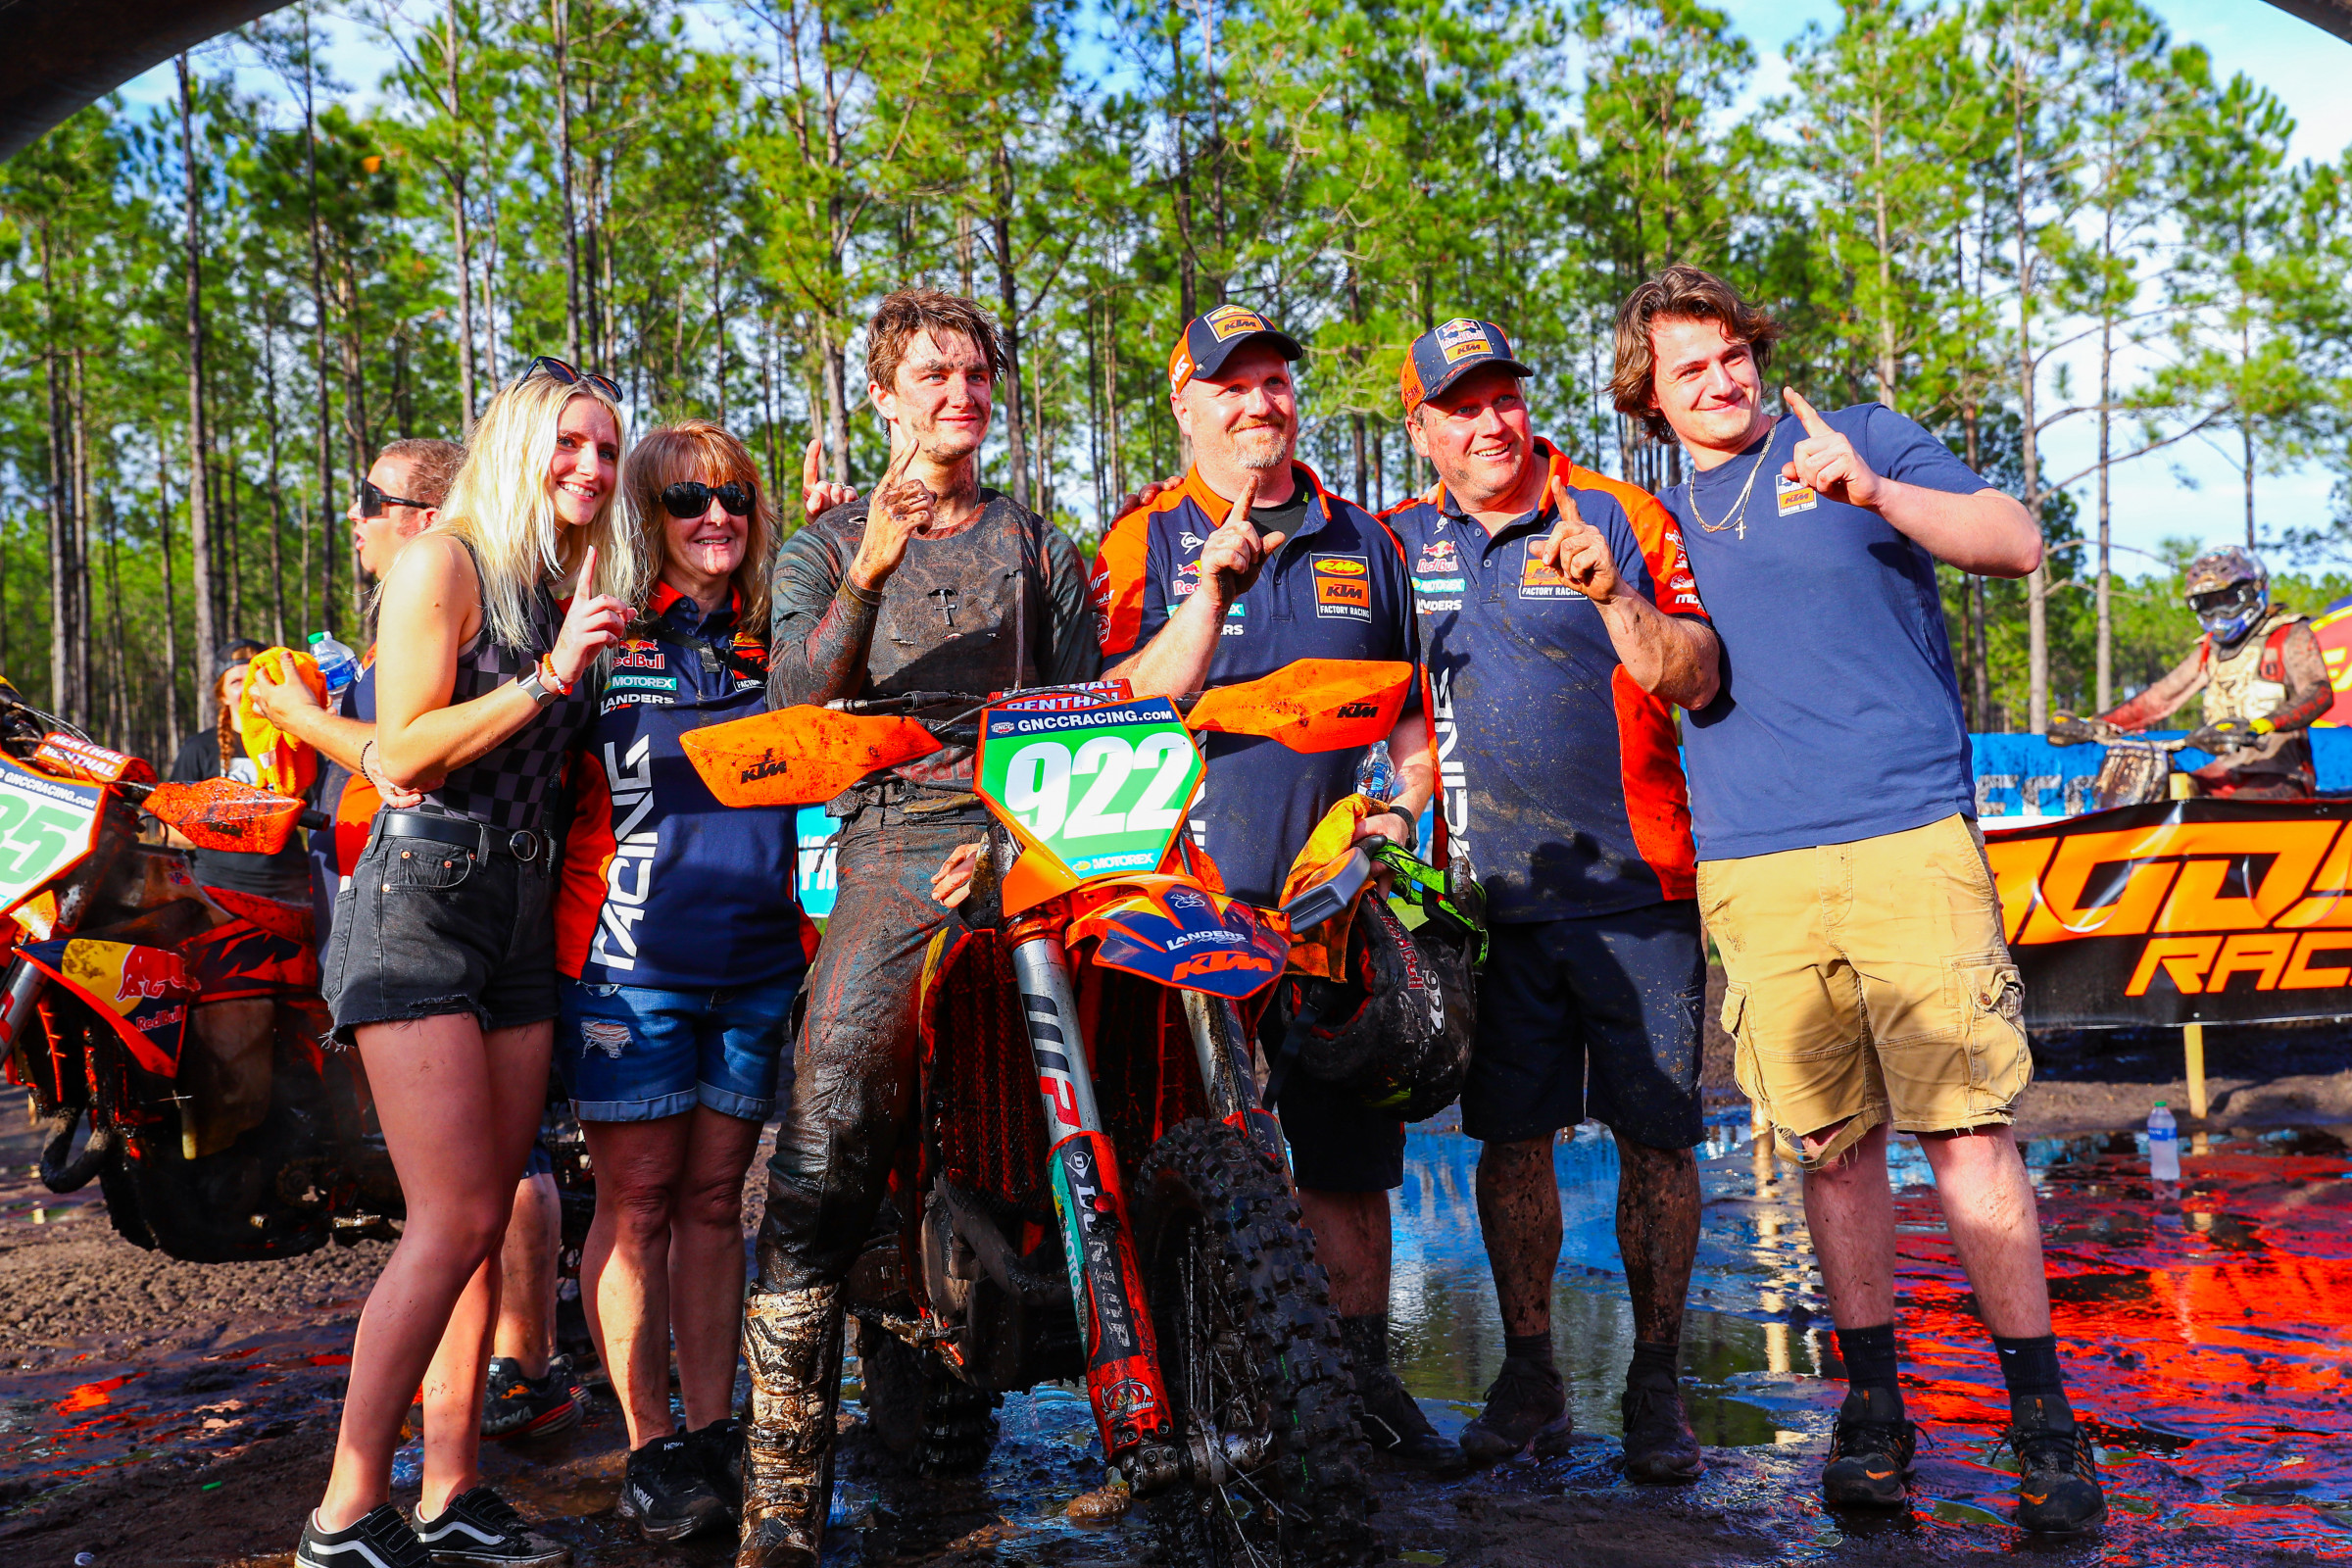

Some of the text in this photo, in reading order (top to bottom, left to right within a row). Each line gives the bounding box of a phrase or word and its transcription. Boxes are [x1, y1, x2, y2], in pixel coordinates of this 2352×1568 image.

[1224, 319, 1256, 332] KTM
[1443, 329, 1486, 348] Red Bull
[1416, 556, 1458, 572] Red Bull
[1326, 584, 1362, 599] KTM
[1320, 605, 1370, 618] FACTORY RACING
[612, 653, 664, 669] ed Bull
[612, 676, 673, 688] MOTOREX
[600, 694, 675, 716] LANDERS
[1337, 702, 1379, 717] KTM
[740, 760, 787, 784] KTM
[1430, 666, 1478, 882] ACING
[1004, 731, 1194, 843] 922
[590, 733, 658, 970] RACING
[1093, 854, 1154, 869] MOTOREX
[1166, 930, 1247, 951] LANDERS
[1172, 950, 1273, 982] KTM
[1400, 950, 1424, 989] Bull
[2125, 931, 2352, 996] RAC
[1423, 969, 1446, 1036] 922
[136, 1004, 182, 1032] Red Bull
